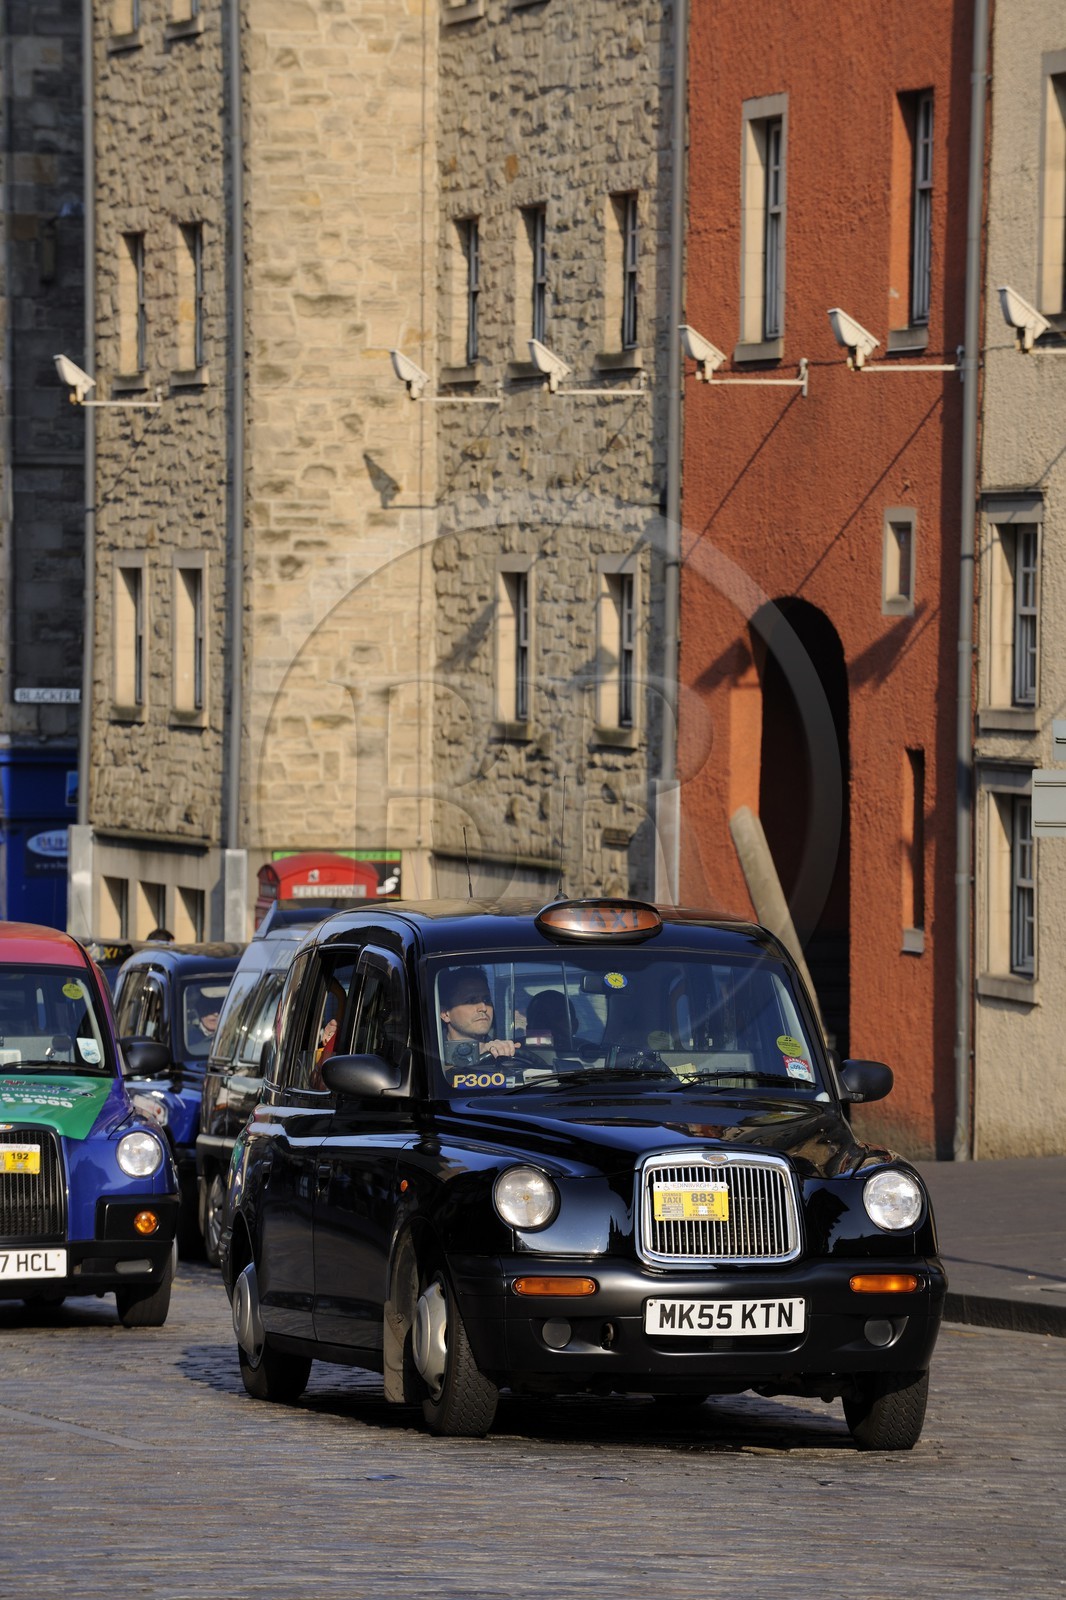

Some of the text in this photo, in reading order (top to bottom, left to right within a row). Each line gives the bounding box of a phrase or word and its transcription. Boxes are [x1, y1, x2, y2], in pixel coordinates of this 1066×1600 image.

[573, 908, 639, 929] TAXI
[453, 1072, 505, 1088] P300
[22, 1096, 73, 1108] 5000
[11, 1152, 29, 1160] 192
[691, 1192, 715, 1202] 883
[17, 1253, 56, 1272] HCL
[659, 1302, 794, 1329] MK55 KTN
